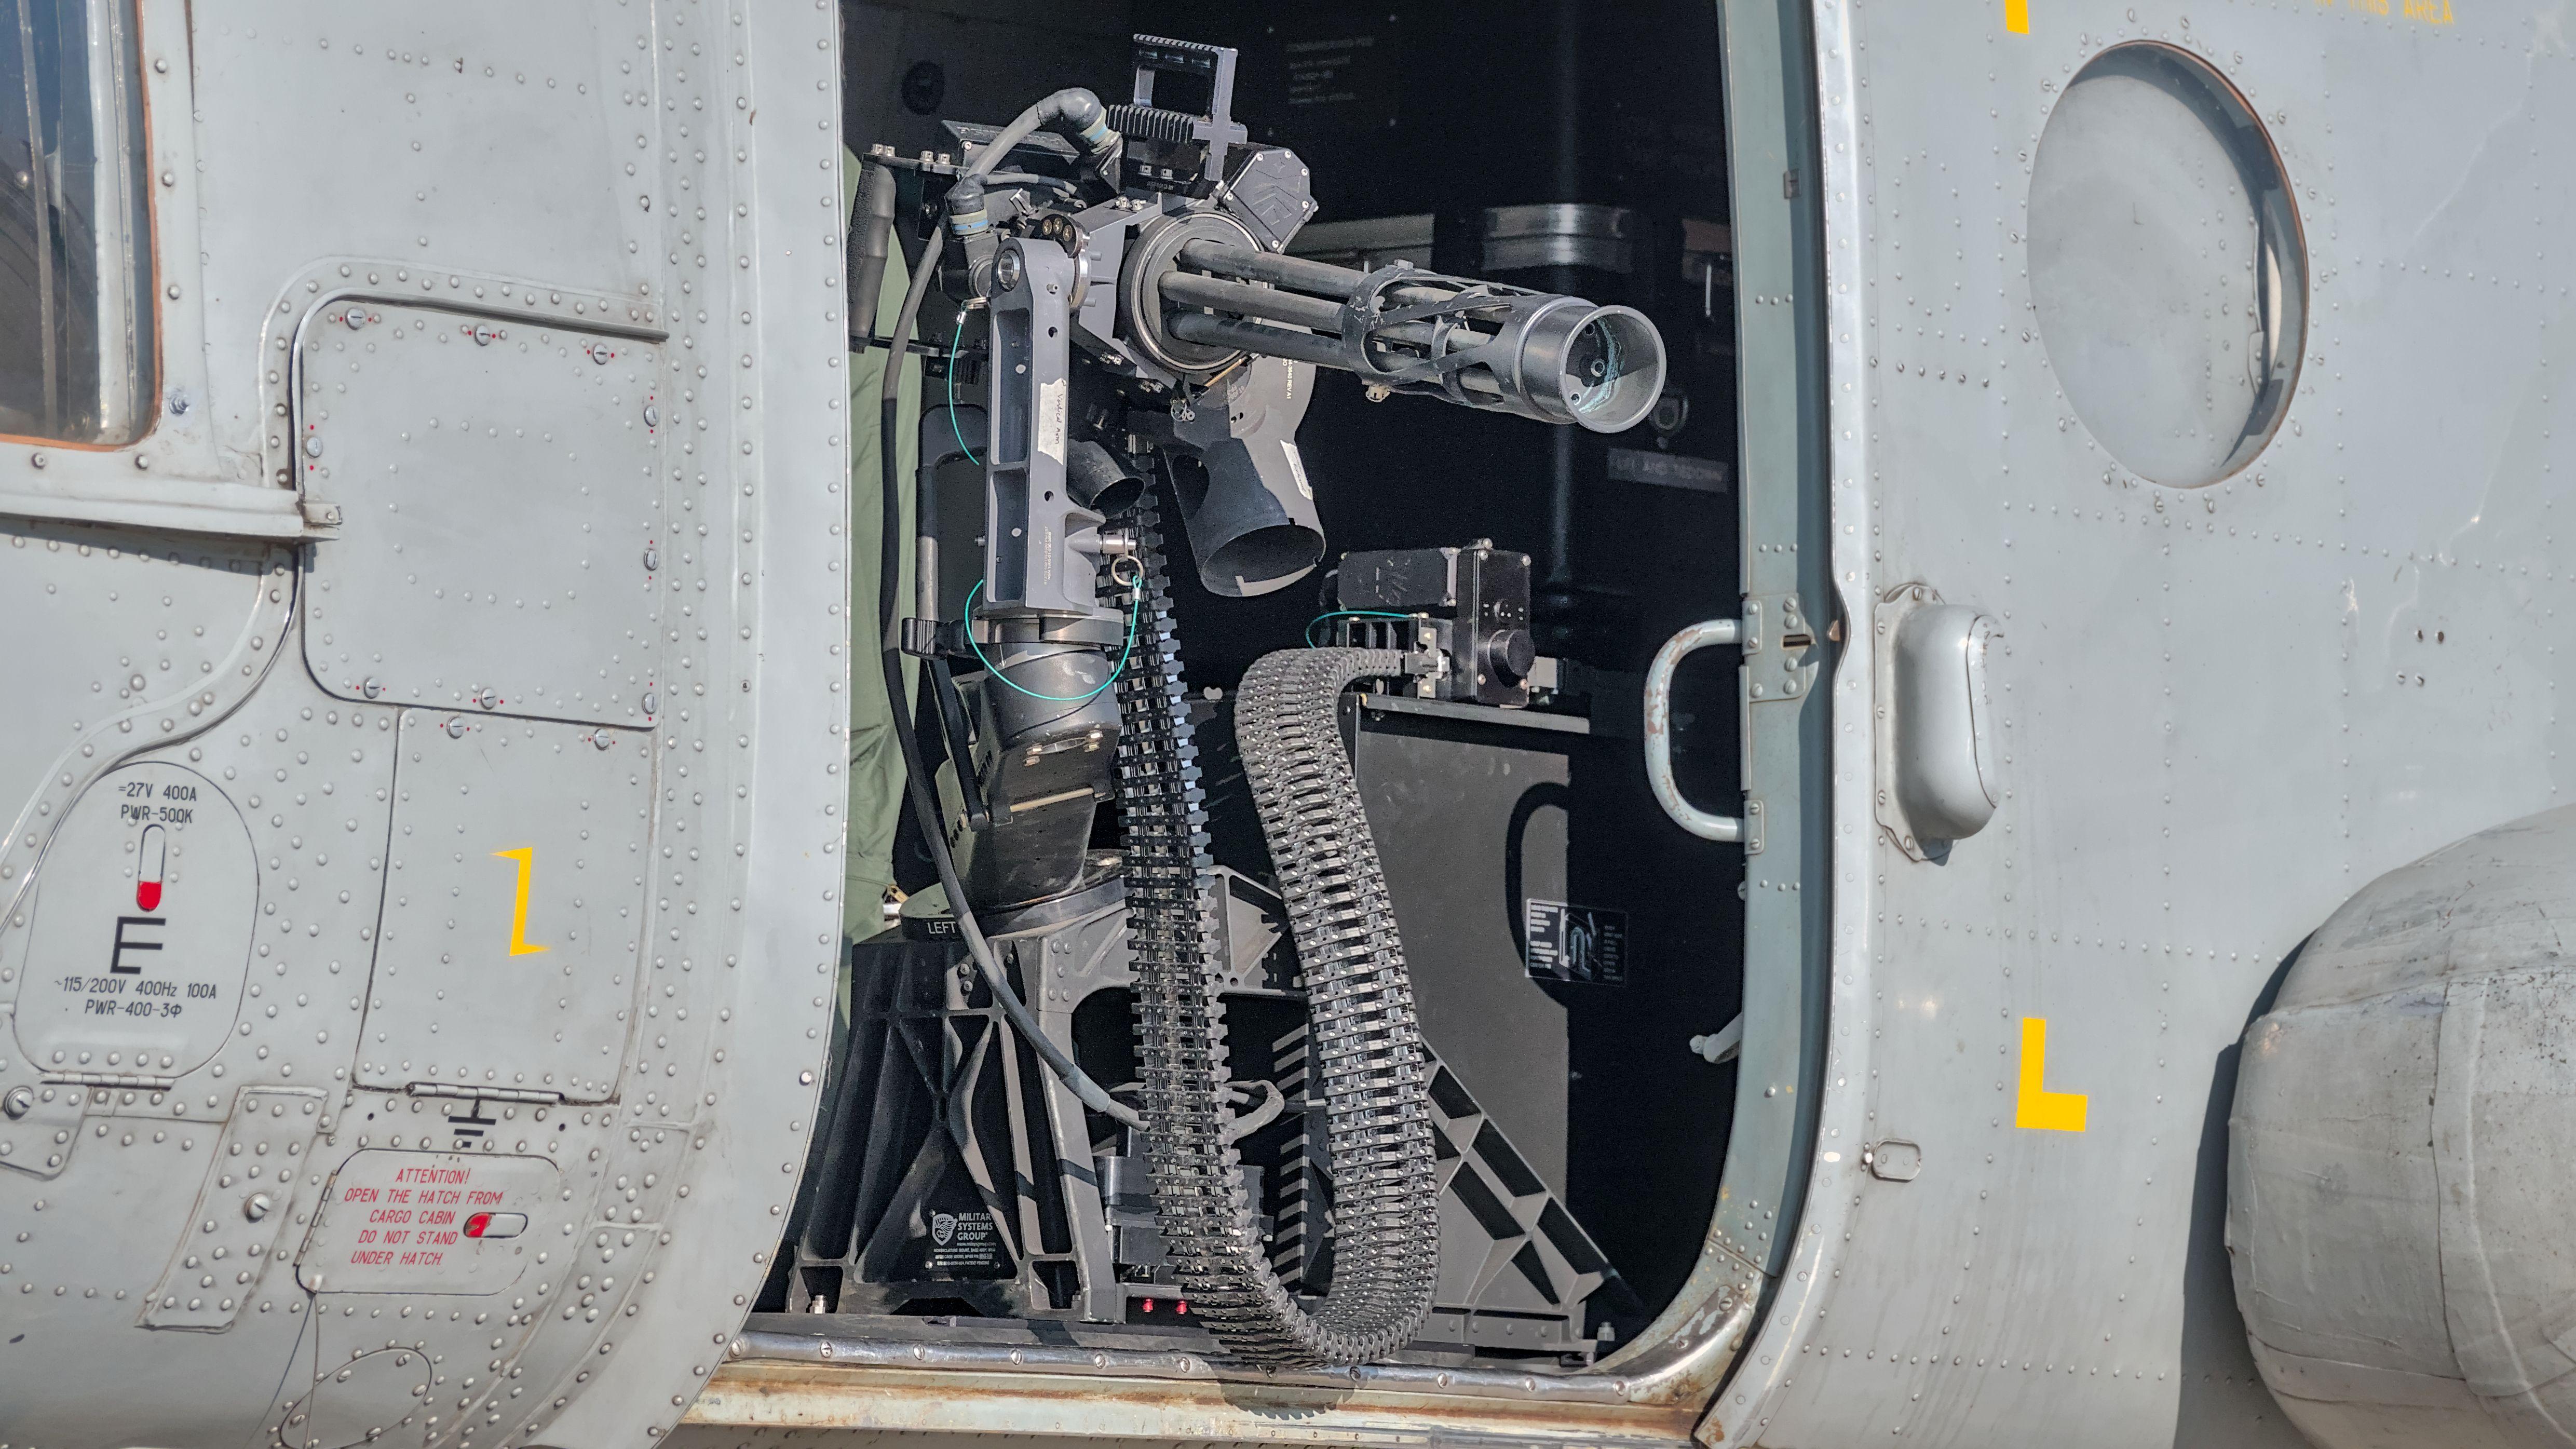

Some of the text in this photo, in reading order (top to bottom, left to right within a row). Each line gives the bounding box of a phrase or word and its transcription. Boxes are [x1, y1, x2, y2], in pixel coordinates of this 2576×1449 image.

[163, 785, 196, 801] 400A
[121, 804, 193, 823] PWR-500K
[927, 921, 956, 935] LEFT
[135, 981, 177, 997] 400Hz
[187, 983, 216, 999] 100A
[395, 1168, 471, 1184] ATTENTION!
[344, 1188, 503, 1205] OPEN THE HATCH FROM
[370, 1209, 456, 1225] CARGO CABIN
[957, 1222, 993, 1230] SYSTEMS
[358, 1230, 458, 1245] DO NOT STAND
[351, 1251, 394, 1265] UNDER
